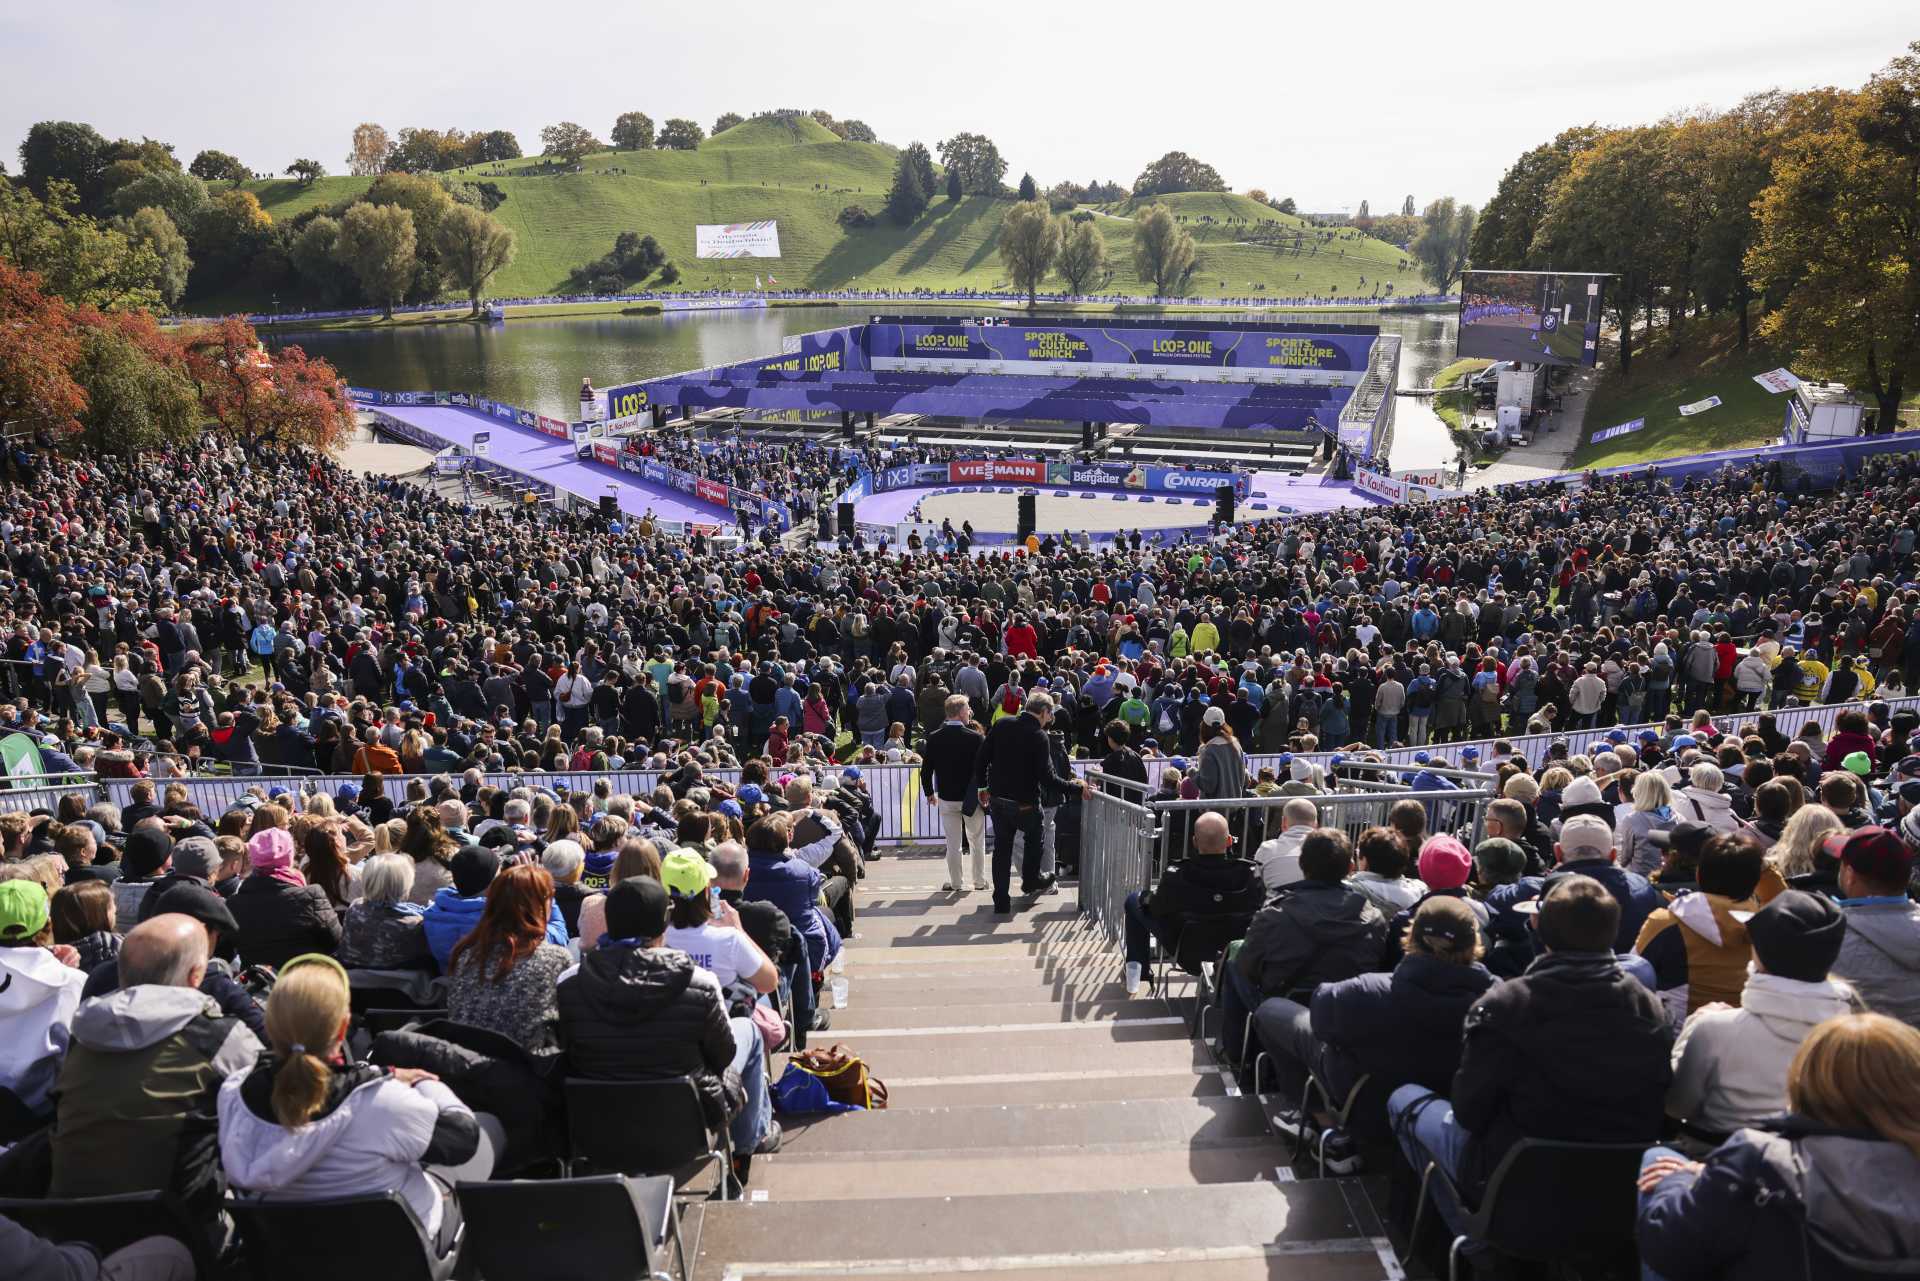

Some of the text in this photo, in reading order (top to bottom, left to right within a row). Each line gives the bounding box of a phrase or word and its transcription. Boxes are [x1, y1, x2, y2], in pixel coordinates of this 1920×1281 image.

[1024, 332, 1069, 342] SPORTS.
[1265, 337, 1315, 348] SPORTS.
[1039, 340, 1089, 350] CULTURE.
[1028, 348, 1076, 359] MUNICH.
[1281, 347, 1337, 358] CULTURE.
[1269, 355, 1322, 367] MUNICH.
[887, 469, 910, 487] iX3
[1073, 470, 1120, 485] Bergader
[1164, 472, 1230, 488] CONRAD
[1367, 475, 1401, 499] Kaufland
